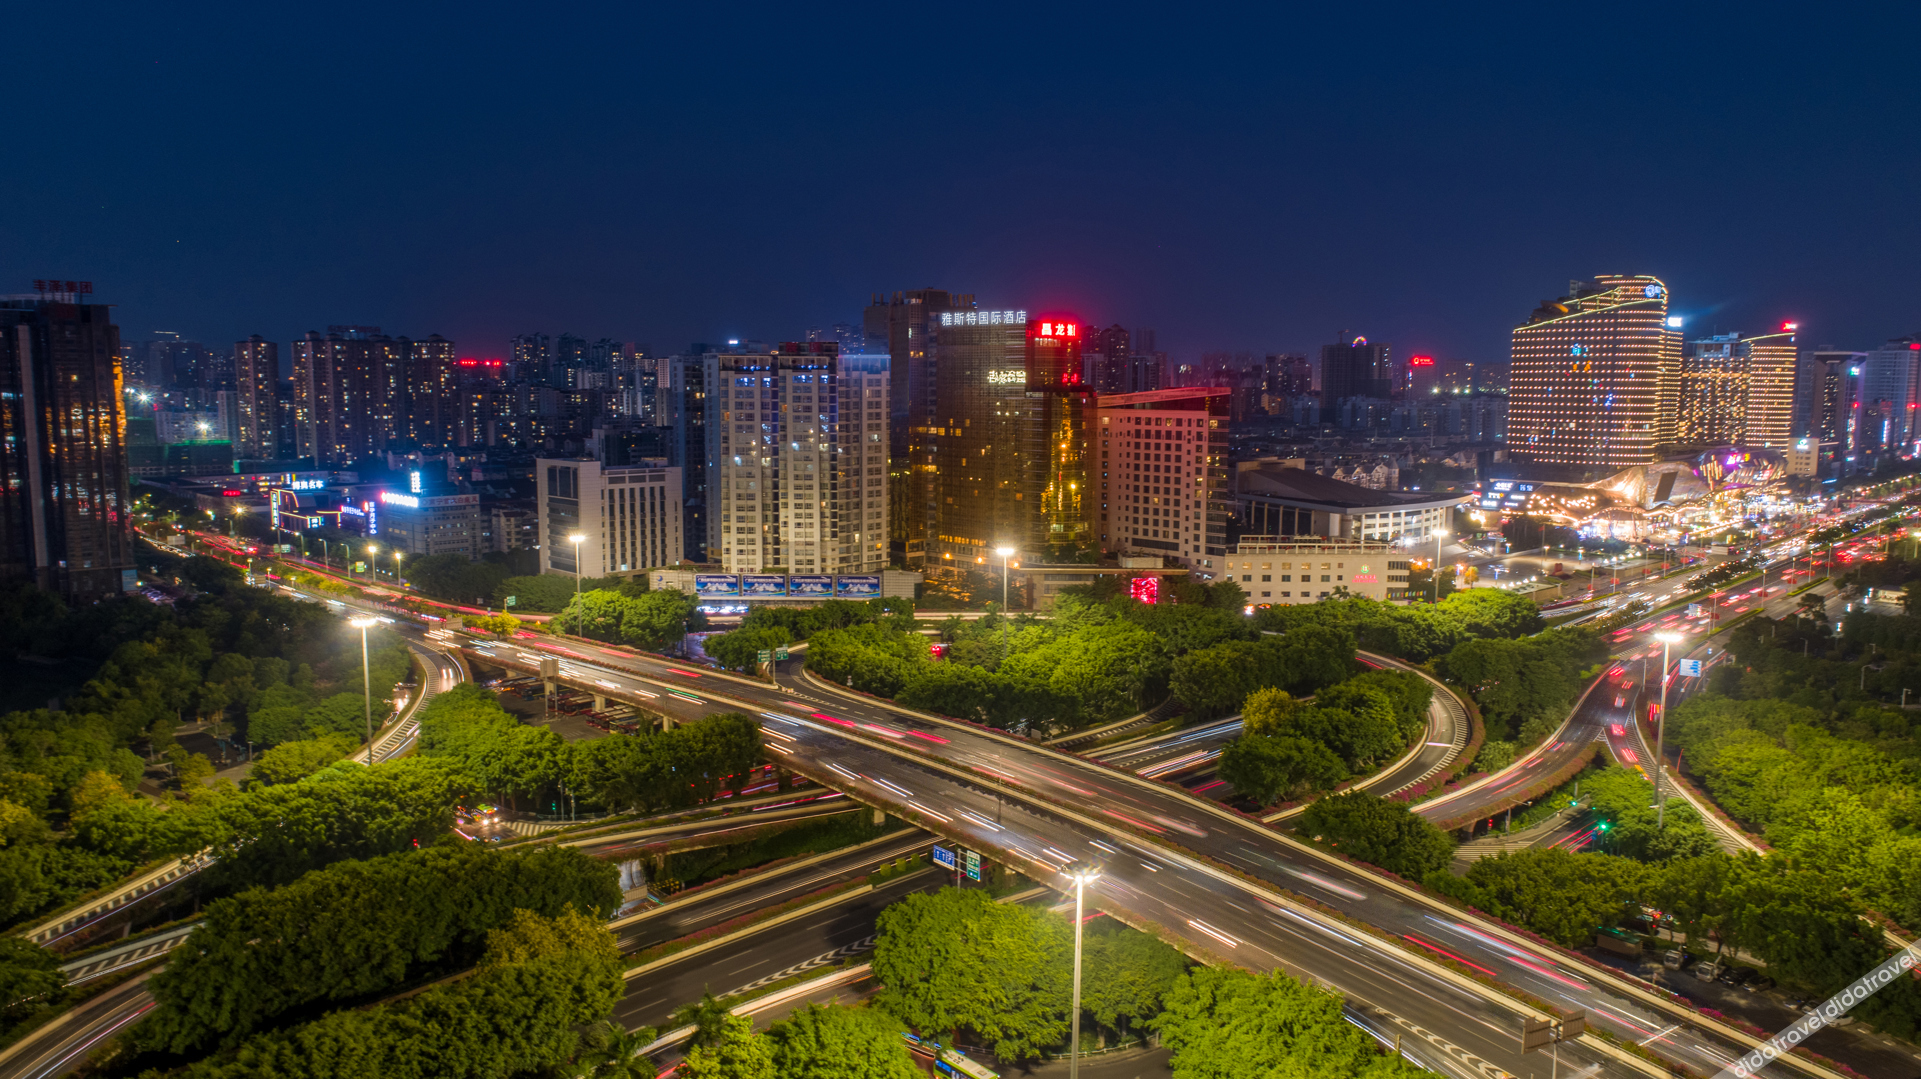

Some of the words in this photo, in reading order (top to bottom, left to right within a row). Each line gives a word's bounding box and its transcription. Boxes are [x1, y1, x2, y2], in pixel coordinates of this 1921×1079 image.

[33, 279, 92, 294] 丰泽集团
[941, 310, 1027, 326] 雅斯特国际酒店
